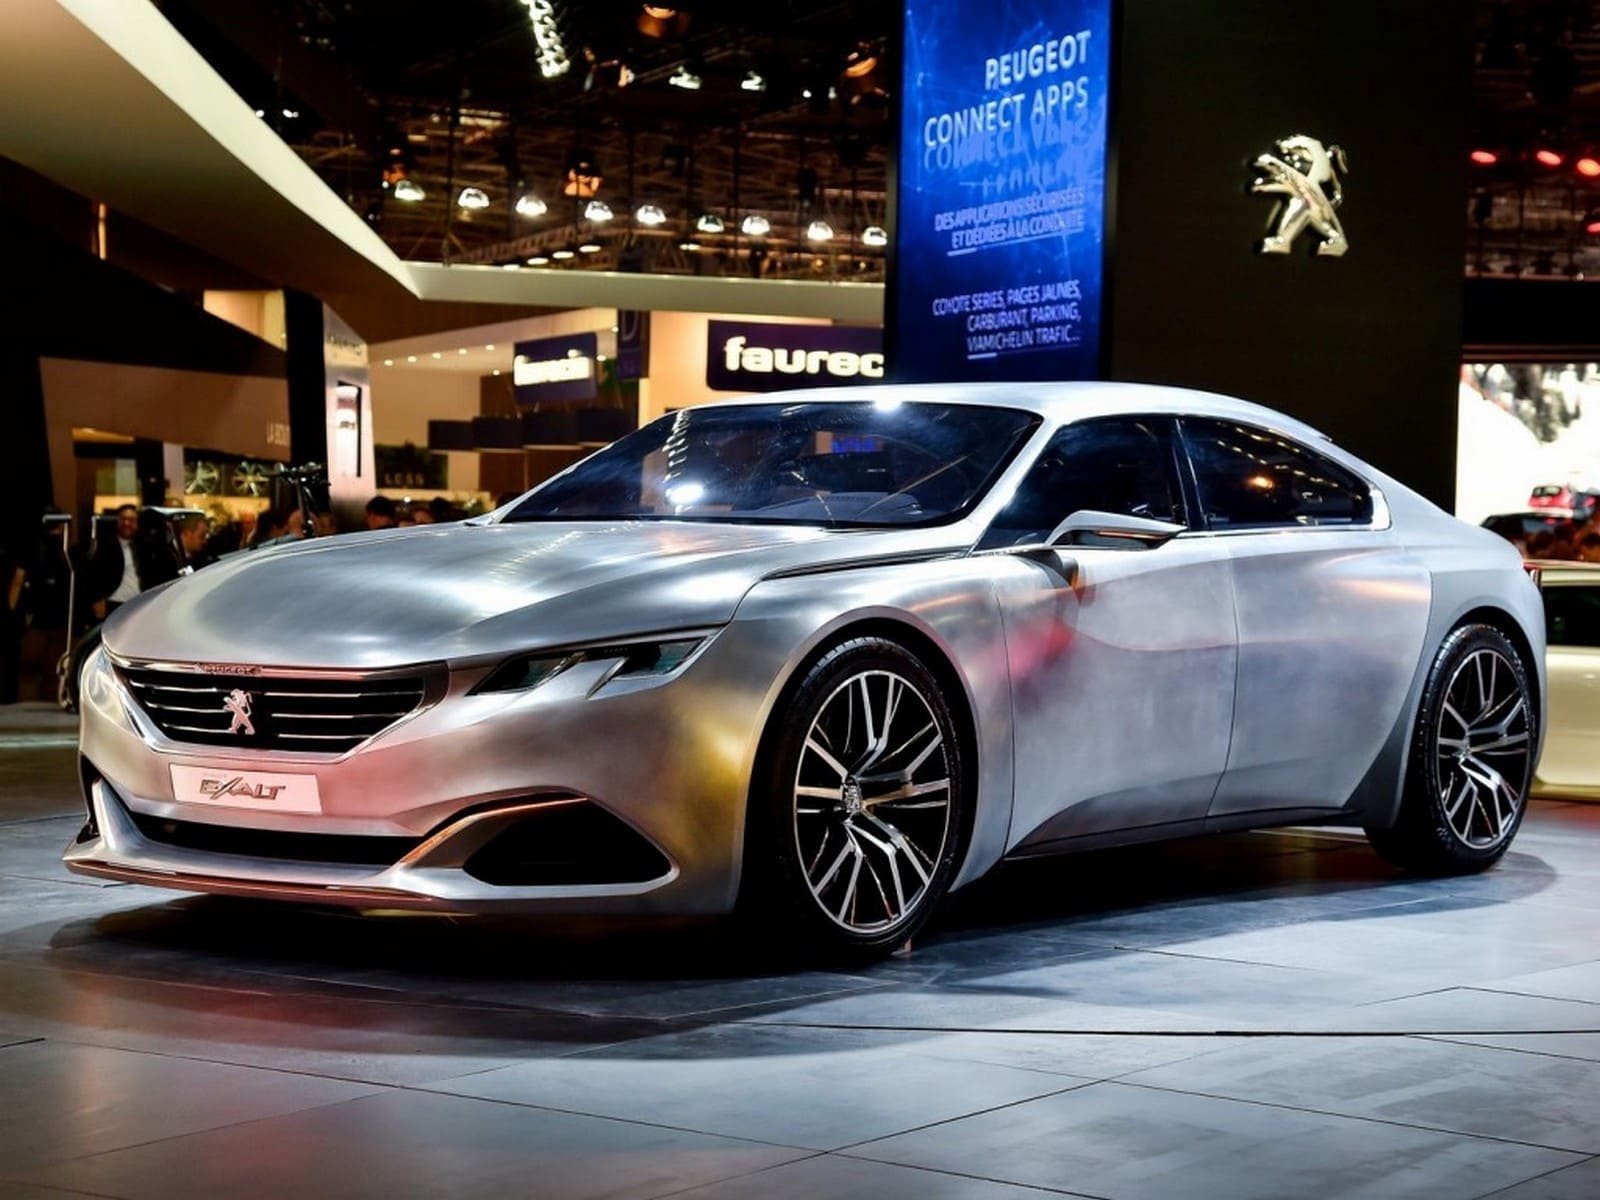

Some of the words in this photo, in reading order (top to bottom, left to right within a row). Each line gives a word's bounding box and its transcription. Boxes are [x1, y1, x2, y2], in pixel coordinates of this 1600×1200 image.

[985, 29, 1092, 90] PEUGEOT
[924, 93, 1026, 147] CONNECT
[1030, 76, 1089, 121] APPS
[952, 230, 965, 248] ET
[1007, 285, 1040, 305] PAGES
[724, 335, 884, 378] faurec
